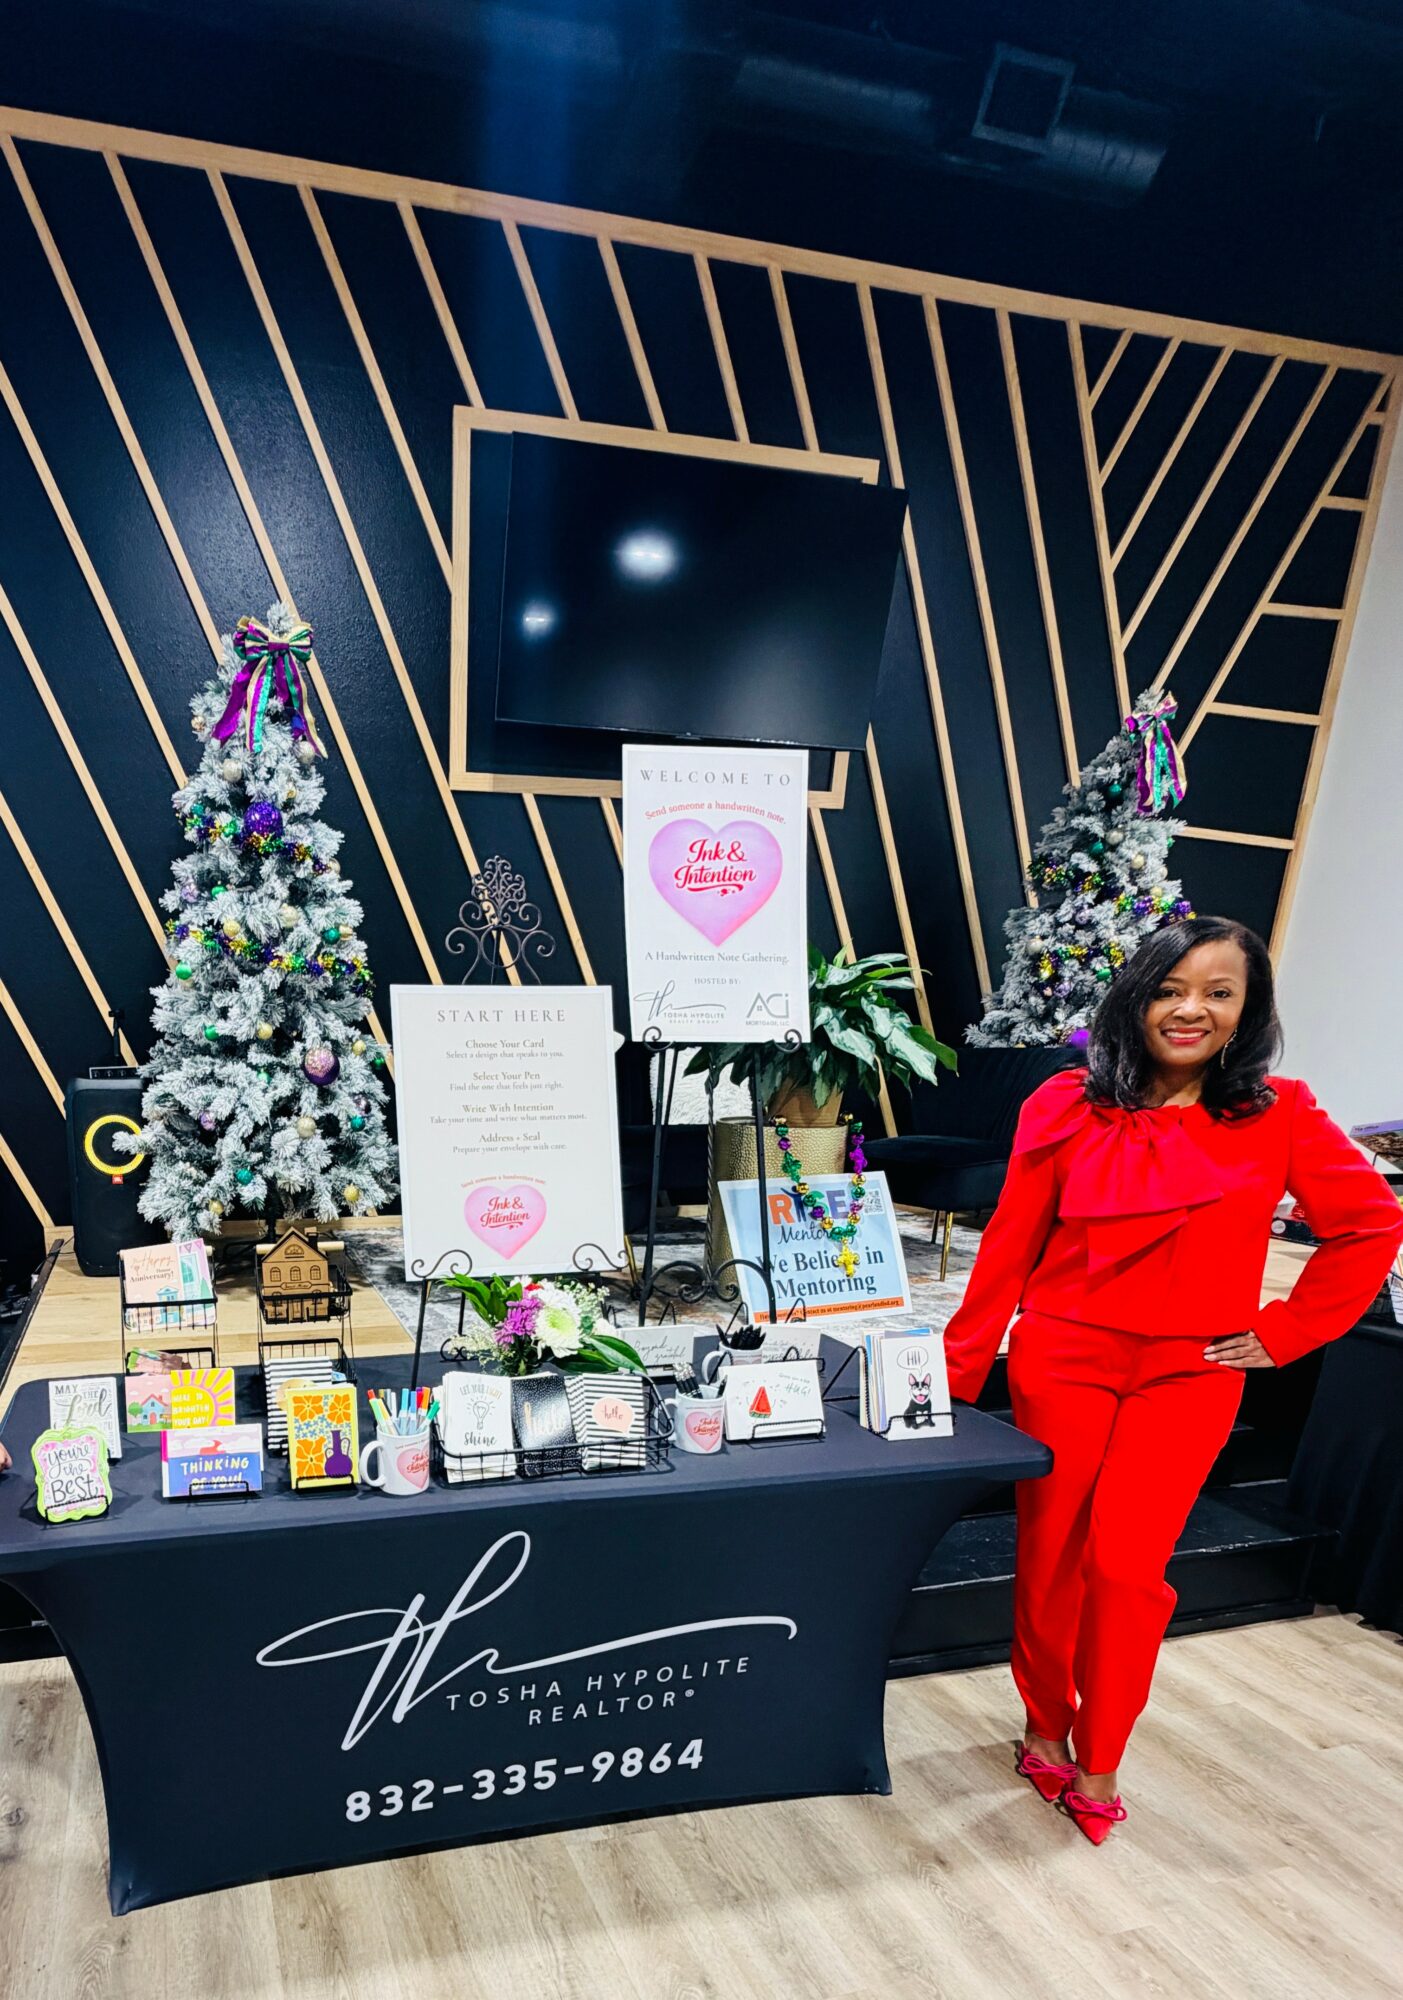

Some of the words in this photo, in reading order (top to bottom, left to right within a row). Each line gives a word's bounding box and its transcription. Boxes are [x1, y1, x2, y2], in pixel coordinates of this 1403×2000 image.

[640, 769, 749, 785] WELCOME
[764, 773, 791, 786] TO
[644, 805, 667, 820] Send
[668, 801, 705, 813] someone
[715, 800, 765, 817] handwritten
[766, 811, 786, 825] note.
[687, 838, 726, 864] Ink
[727, 840, 748, 862] &
[674, 865, 757, 889] Intention
[645, 951, 653, 961] A
[656, 951, 715, 962] Handwritten
[718, 952, 740, 962] Note
[694, 977, 727, 985] HOSTED
[437, 1009, 504, 1023] START
[515, 1009, 566, 1022] HERE
[465, 1039, 498, 1049] Choose
[500, 1039, 520, 1049] Your
[523, 1038, 545, 1048] Card
[446, 1051, 468, 1059] Select
[475, 1051, 498, 1060] design
[516, 1051, 539, 1060] speaks
[549, 1051, 565, 1060] you.
[473, 1071, 499, 1081] Select
[501, 1071, 521, 1080] Your
[524, 1071, 541, 1080] Pen
[449, 1083, 466, 1091] Find
[468, 1082, 480, 1090] the
[496, 1082, 510, 1090] that
[512, 1081, 528, 1089] feels
[530, 1082, 543, 1091] just
[544, 1081, 564, 1091] right.
[462, 1104, 487, 1113] Write
[489, 1103, 511, 1113] With
[513, 1102, 554, 1112] Intention
[430, 1115, 447, 1124] Take
[448, 1116, 465, 1126] your
[467, 1115, 483, 1123] time
[500, 1114, 518, 1122] write
[520, 1113, 537, 1121] what
[540, 1113, 566, 1121] matters
[568, 1112, 587, 1120] most.
[479, 1133, 514, 1143] Address
[523, 1132, 541, 1141] Seal
[453, 1145, 480, 1155] Prepare
[481, 1146, 498, 1155] your
[500, 1143, 531, 1153] envelope
[533, 1142, 549, 1150] with
[488, 1196, 511, 1212] Ink
[512, 1196, 525, 1209] &
[480, 1211, 531, 1227] Intention
[792, 1250, 861, 1272] Beliee
[865, 1246, 885, 1265] in
[130, 1270, 174, 1283] Anniversary!
[775, 1275, 877, 1299] Mentoring
[55, 1384, 78, 1395] MAY
[82, 1390, 98, 1399] THE
[602, 1405, 624, 1420] hello
[174, 1417, 191, 1426] YOUR
[192, 1416, 209, 1425] DAY!
[446, 1680, 562, 1711] TOSHA
[586, 1656, 751, 1692] HYPOLITE
[345, 1738, 704, 1823] 832-335-9864
